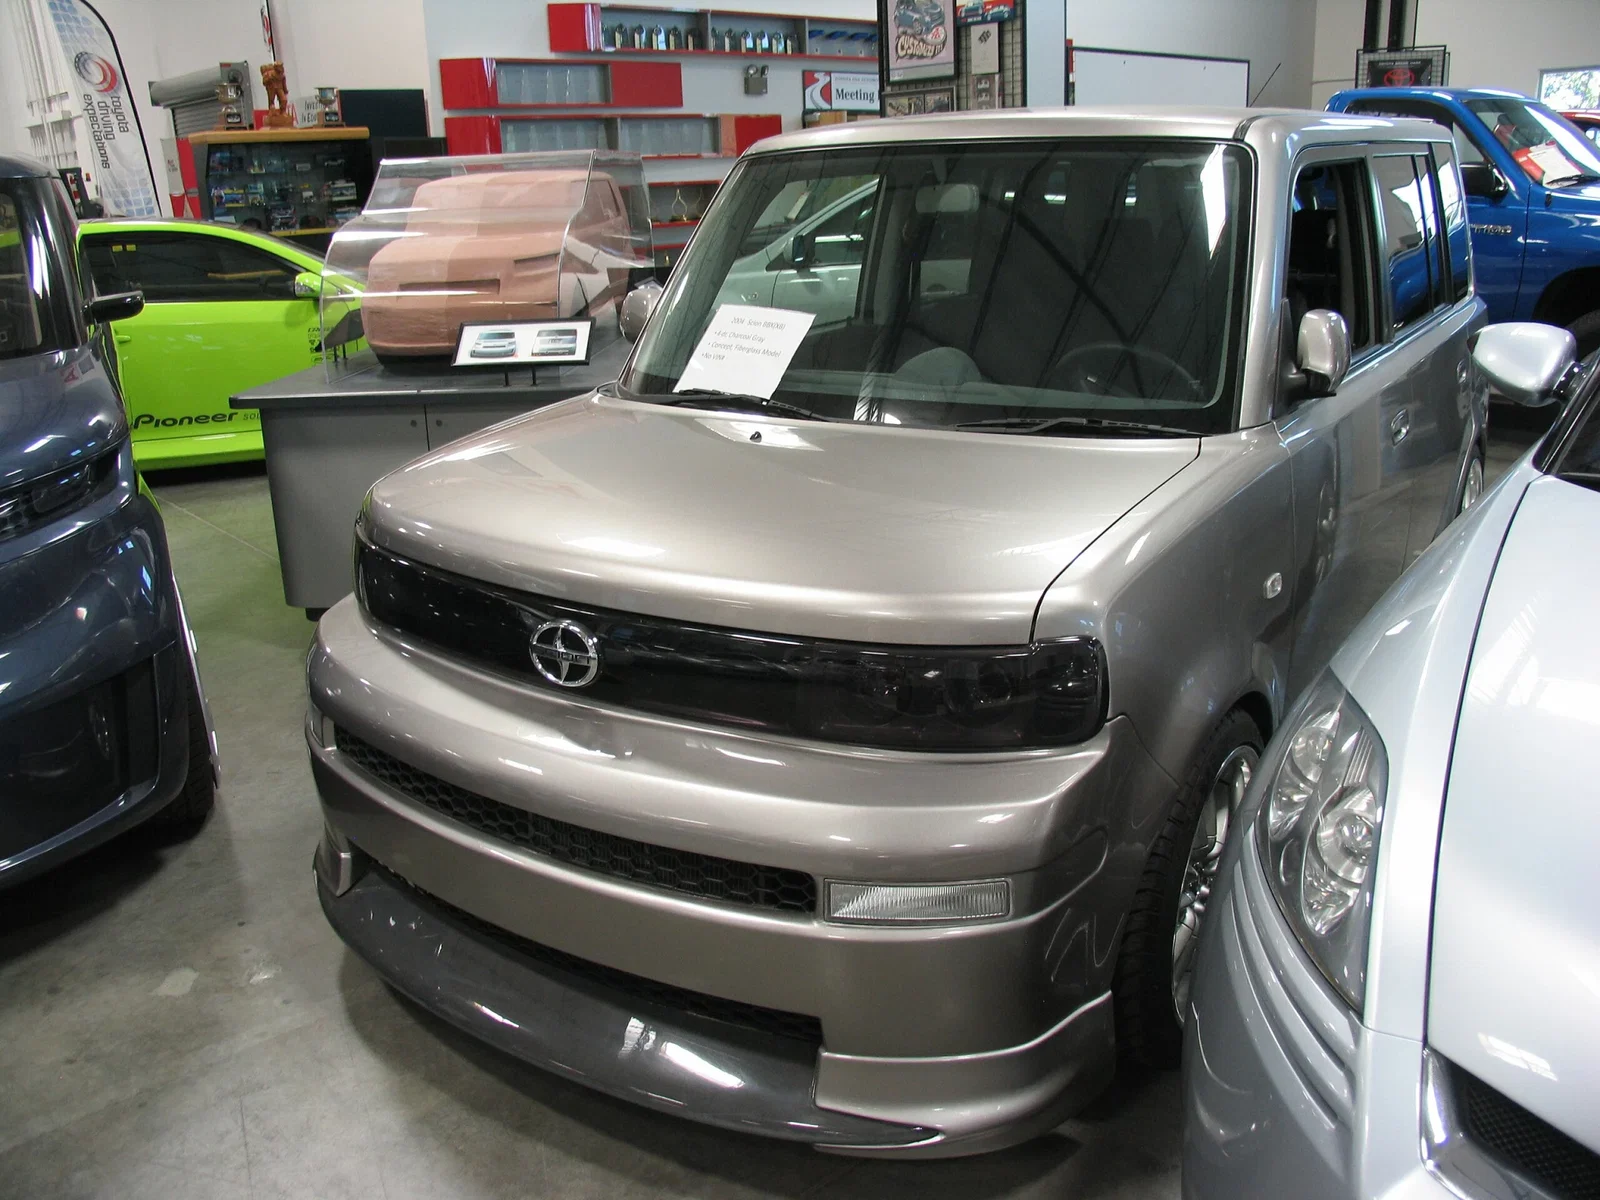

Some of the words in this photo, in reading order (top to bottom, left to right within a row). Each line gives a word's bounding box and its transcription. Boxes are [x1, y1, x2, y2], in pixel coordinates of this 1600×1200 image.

[835, 88, 875, 105] Meeting
[97, 101, 116, 140] driving
[111, 96, 130, 133] toyota
[83, 94, 111, 169] expectations
[748, 319, 761, 327] Scion
[728, 331, 752, 340] Charcoal
[752, 334, 766, 343] Gray
[761, 348, 782, 358] Model
[133, 412, 239, 429] Pioneer
